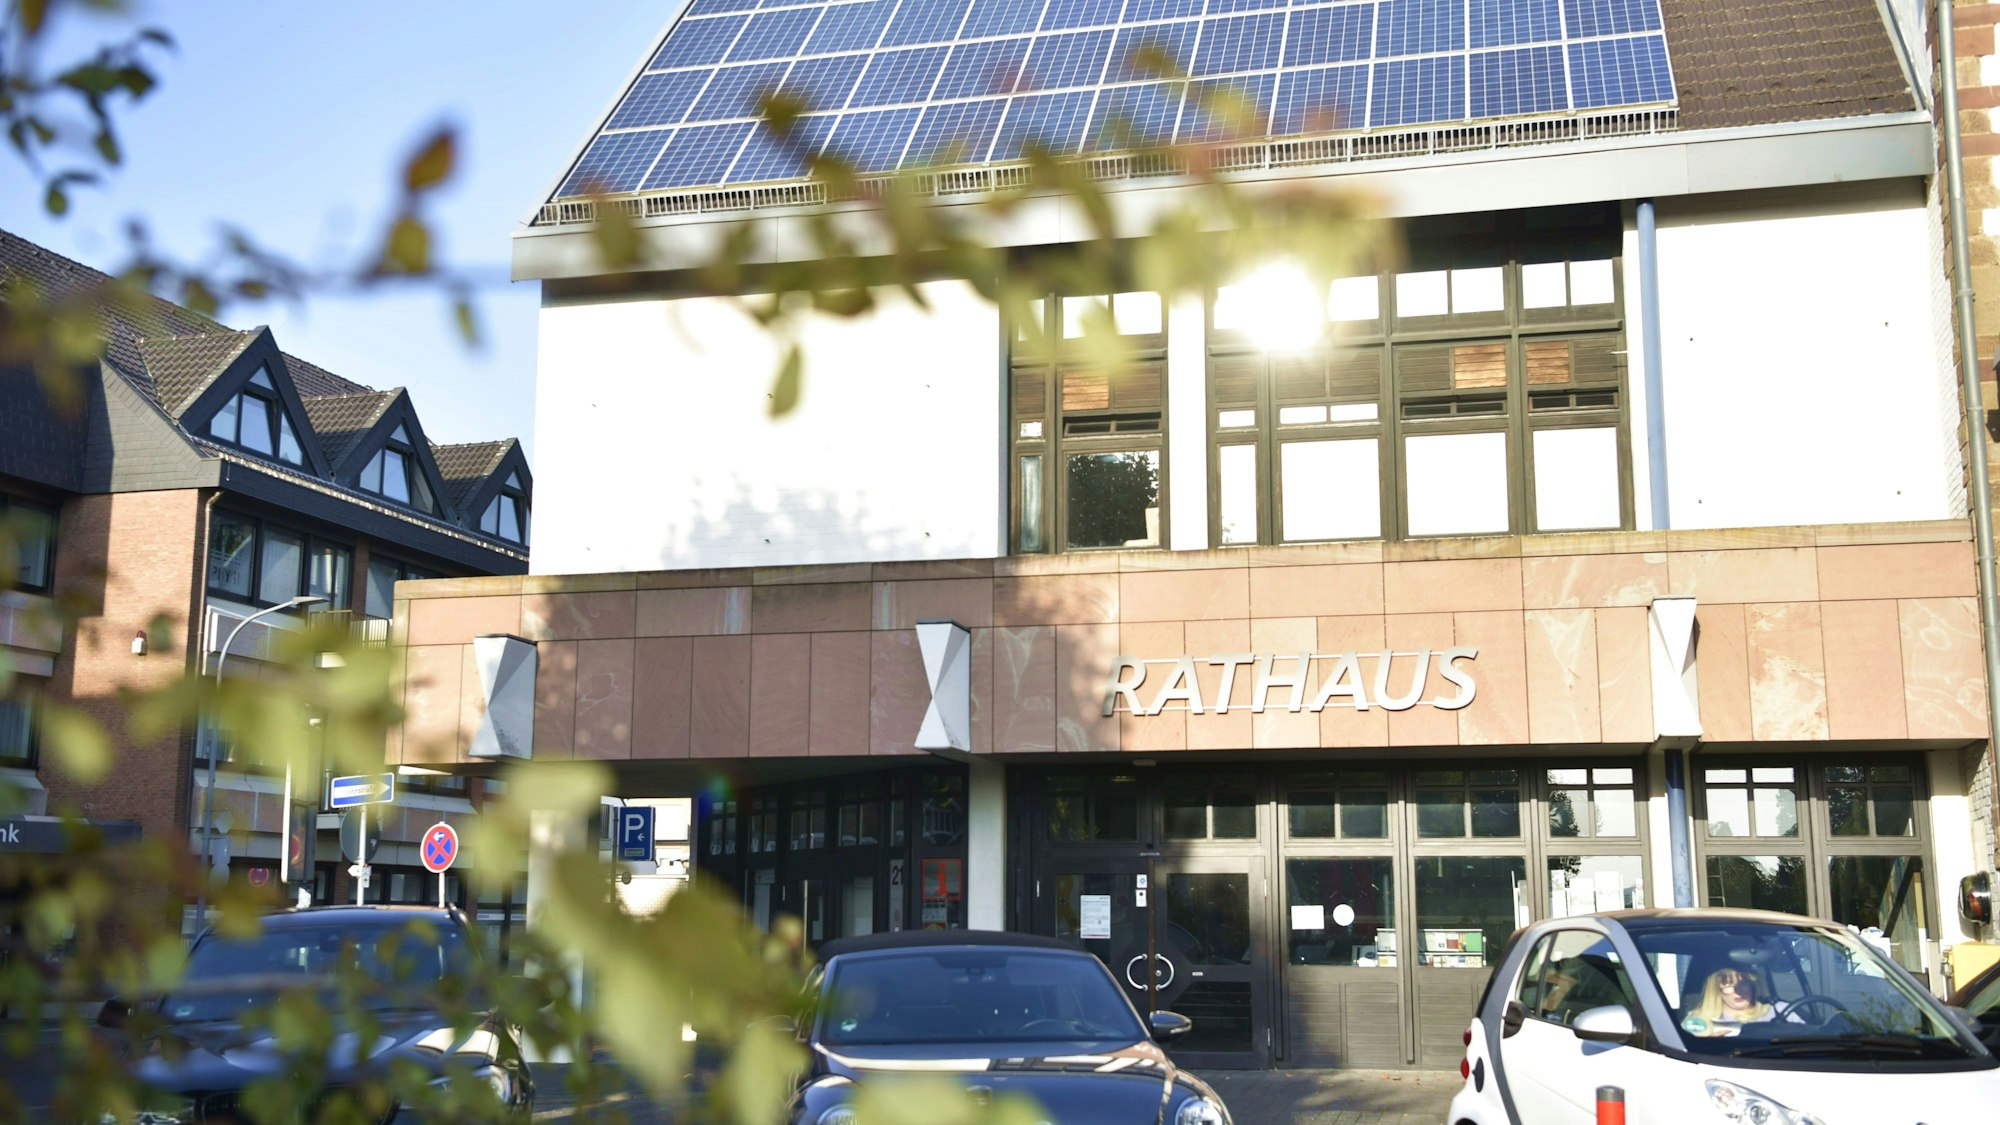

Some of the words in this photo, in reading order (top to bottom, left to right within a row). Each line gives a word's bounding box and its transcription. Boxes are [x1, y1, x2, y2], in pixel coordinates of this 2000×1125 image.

[1102, 647, 1479, 716] RATHAUS
[337, 785, 376, 795] ahnstraße
[624, 813, 645, 843] P
